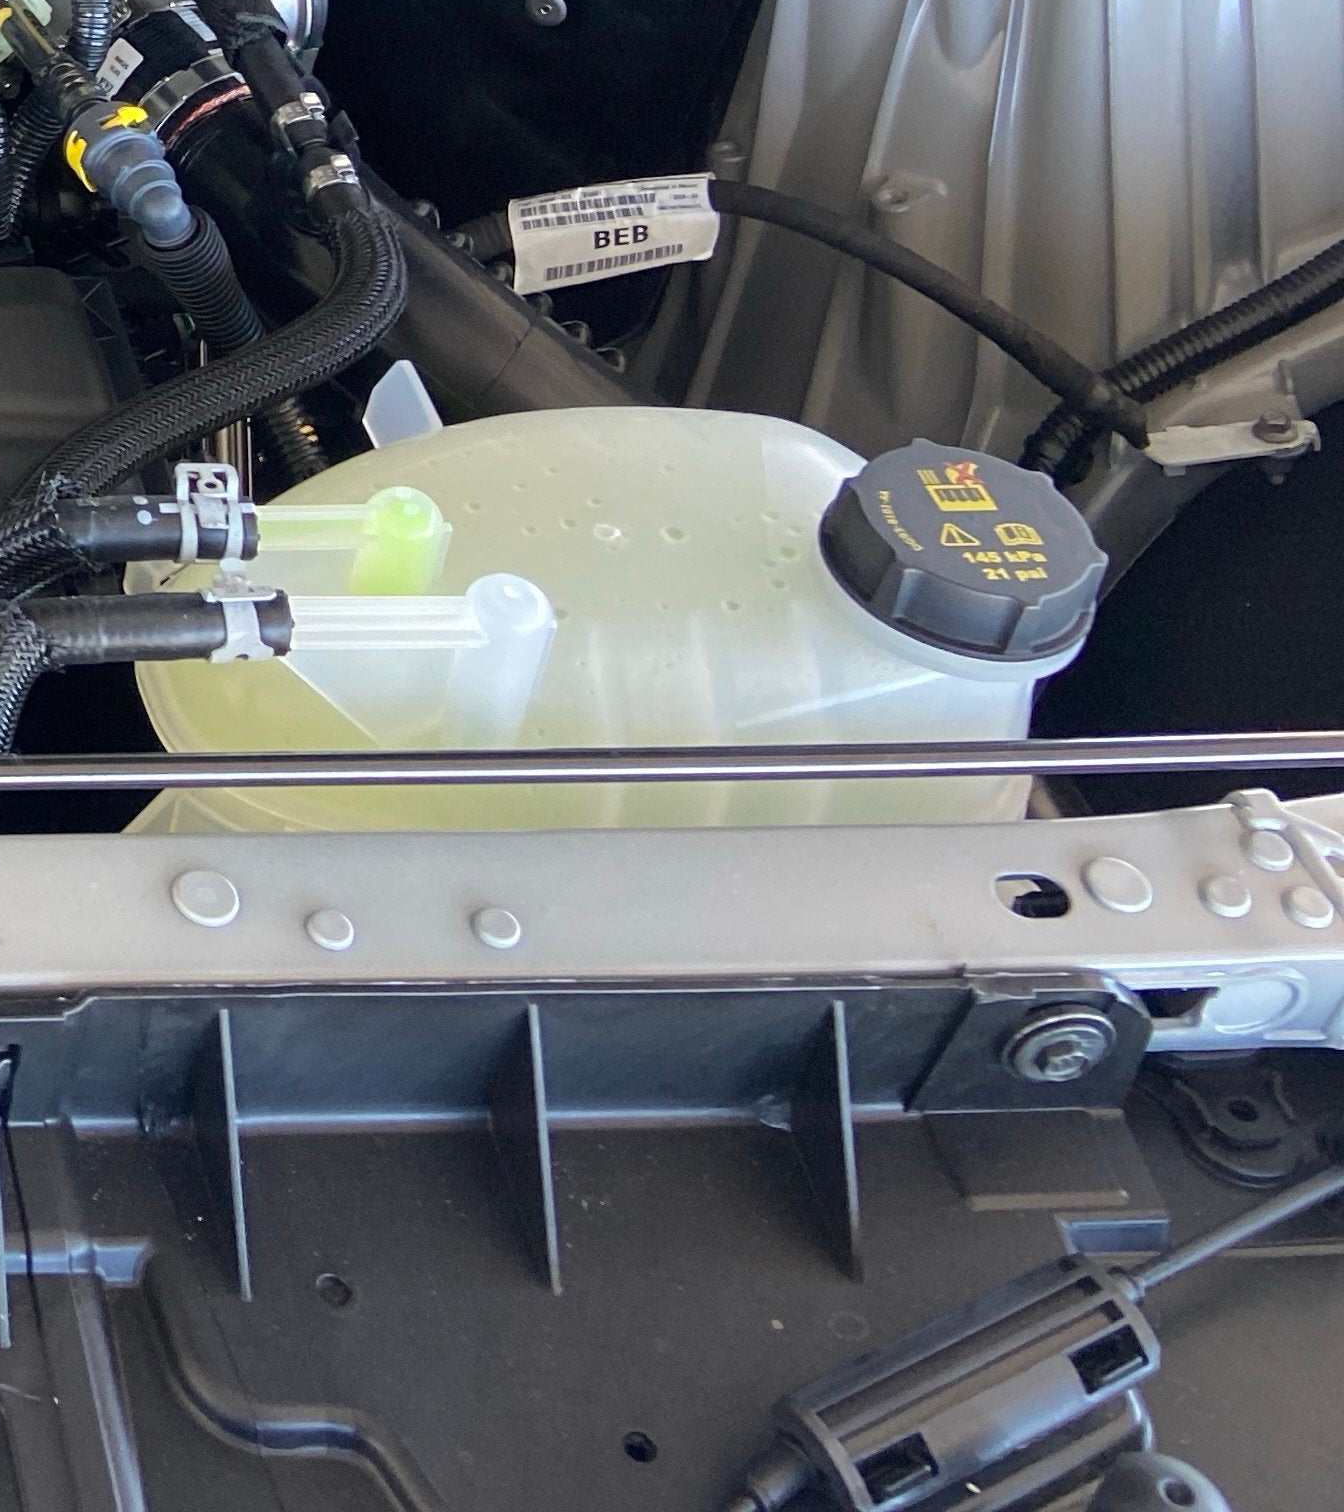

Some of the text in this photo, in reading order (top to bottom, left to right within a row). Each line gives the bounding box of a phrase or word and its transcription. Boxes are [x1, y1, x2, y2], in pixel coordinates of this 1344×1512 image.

[594, 225, 649, 249] BEB
[963, 551, 1048, 564] 145 kPa
[982, 567, 1048, 581] 21 psi
